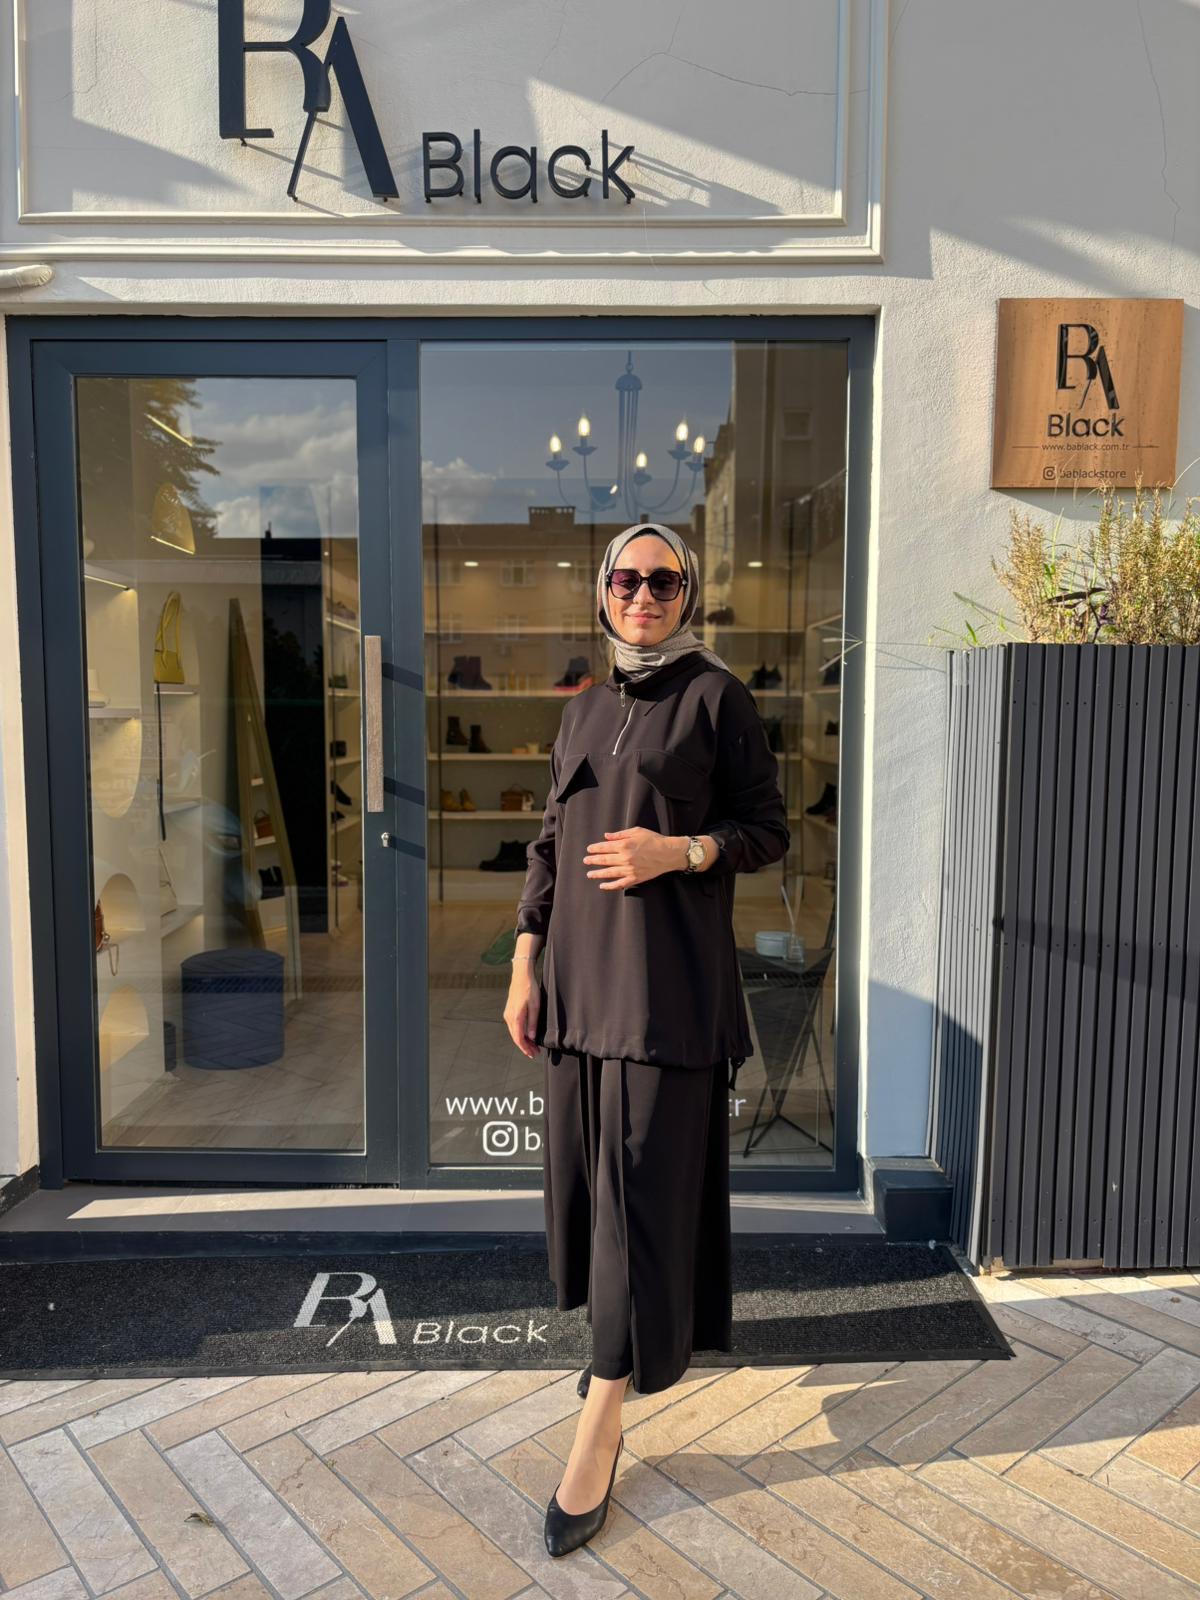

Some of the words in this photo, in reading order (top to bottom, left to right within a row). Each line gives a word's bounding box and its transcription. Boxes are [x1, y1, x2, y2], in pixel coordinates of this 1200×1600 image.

[422, 129, 636, 202] Black
[1047, 413, 1127, 438] Black
[1041, 443, 1130, 452] www.bablack.com.tr
[412, 1320, 549, 1345] Black
